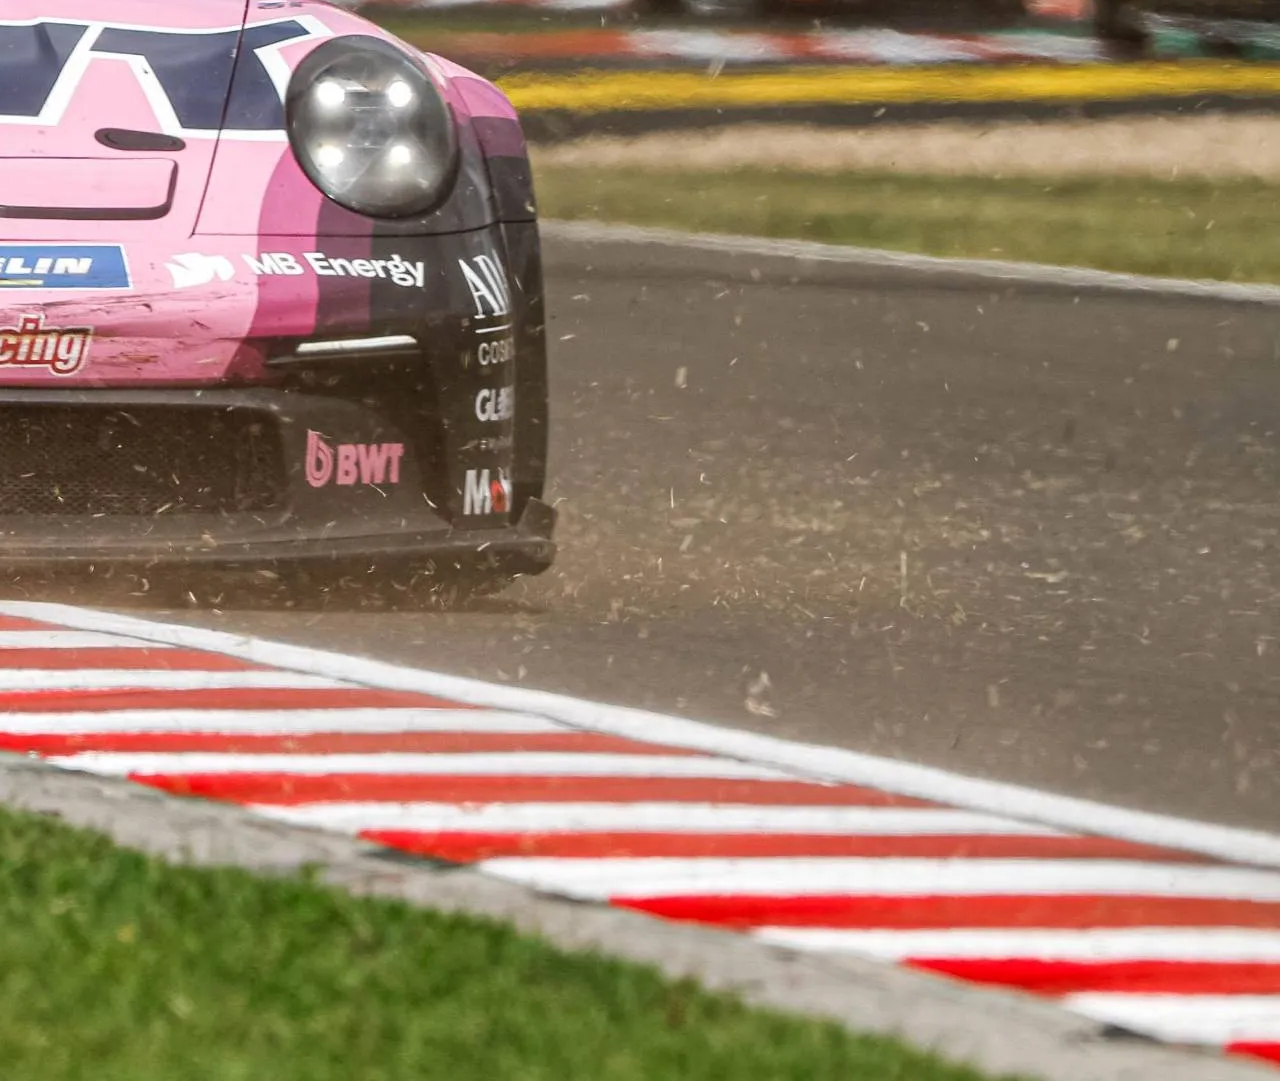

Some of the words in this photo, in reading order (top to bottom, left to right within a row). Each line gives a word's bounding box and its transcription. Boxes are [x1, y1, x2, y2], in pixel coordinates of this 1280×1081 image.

[241, 252, 306, 276] MB
[302, 252, 426, 288] Energy
[335, 442, 406, 486] BWT
